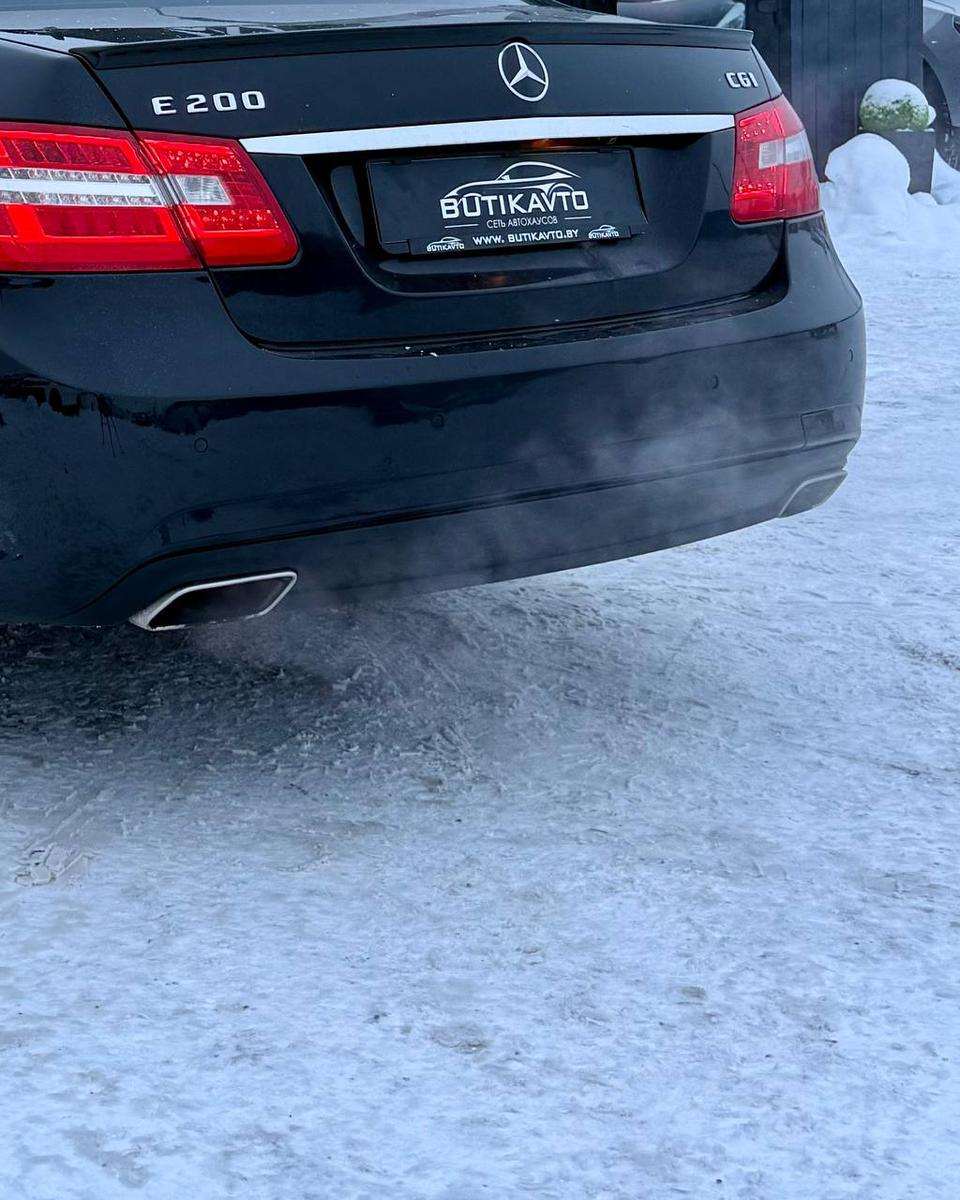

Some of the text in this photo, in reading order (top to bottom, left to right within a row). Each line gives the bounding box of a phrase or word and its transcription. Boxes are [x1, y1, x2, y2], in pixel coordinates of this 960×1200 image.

[725, 72, 759, 88] CGI
[151, 90, 266, 115] E 200
[440, 191, 589, 219] BUTIKAVTO
[486, 215, 558, 229] СЕТЬ АВТОХАУСОВ
[507, 229, 579, 244] BUTIKAVTO.BY
